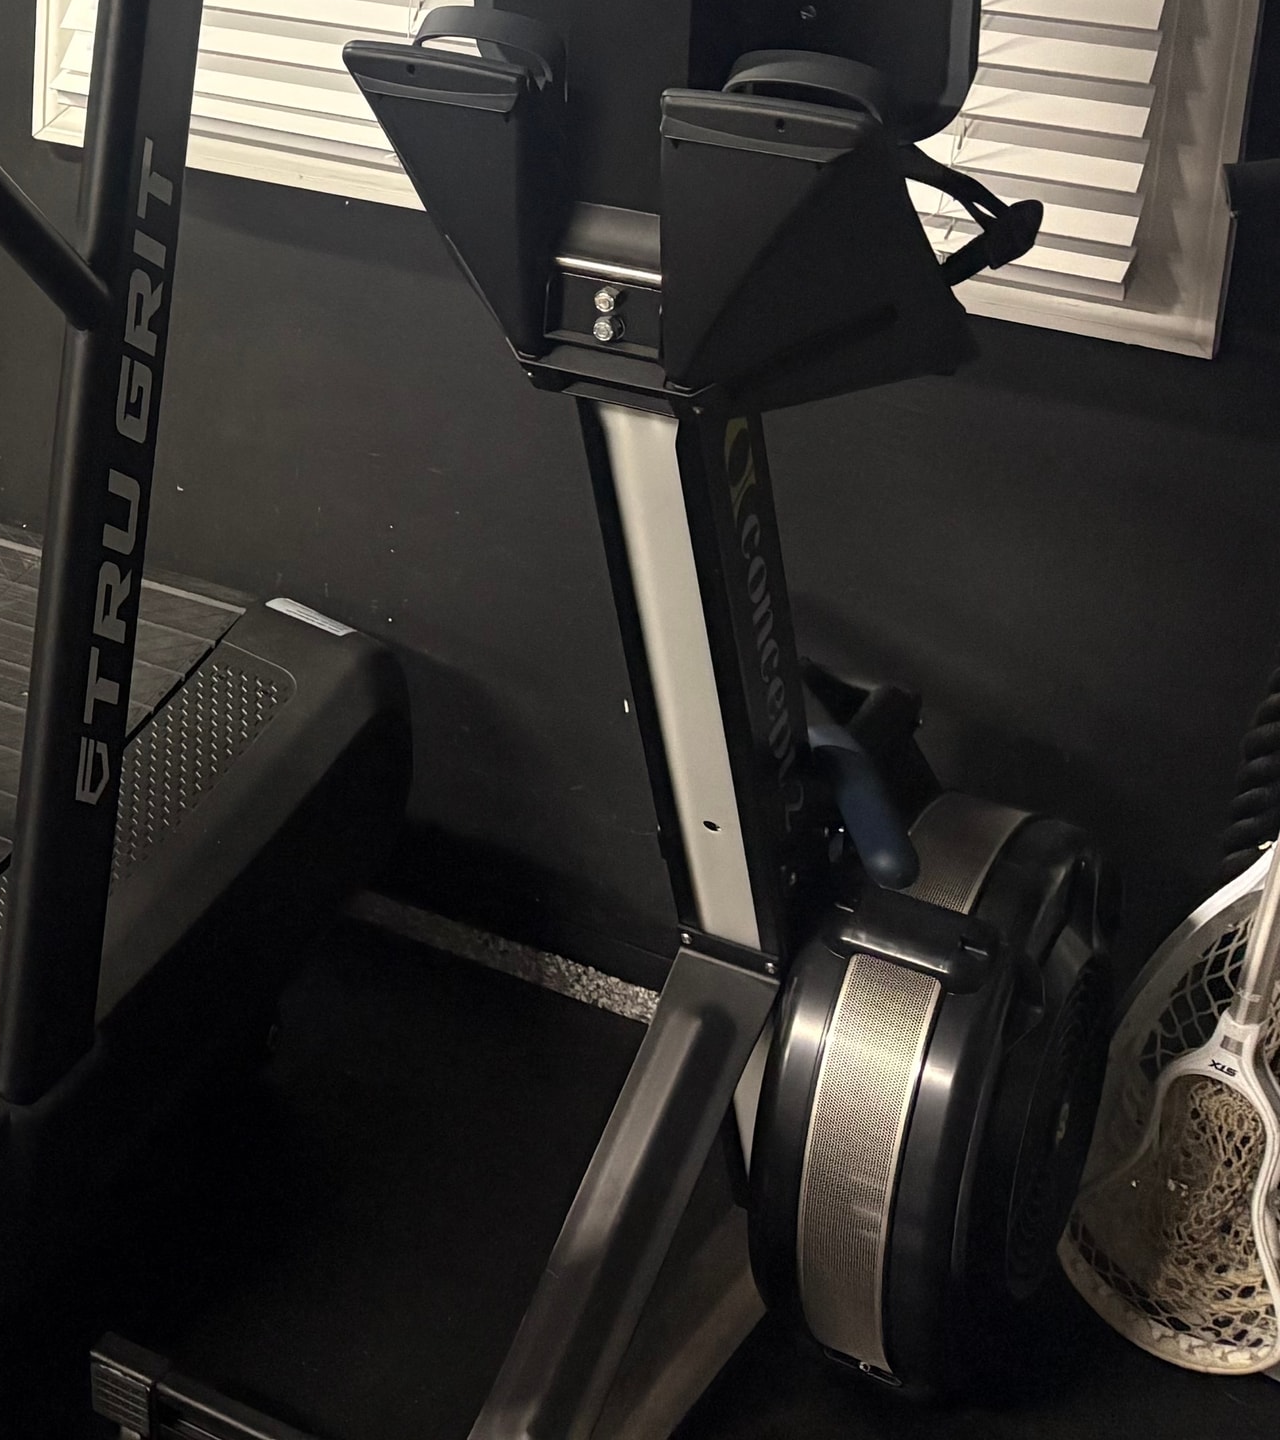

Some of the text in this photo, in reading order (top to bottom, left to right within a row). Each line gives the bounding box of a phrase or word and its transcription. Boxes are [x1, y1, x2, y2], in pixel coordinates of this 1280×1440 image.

[84, 136, 173, 724] TRU GRIT
[1208, 1059, 1238, 1077] STX
